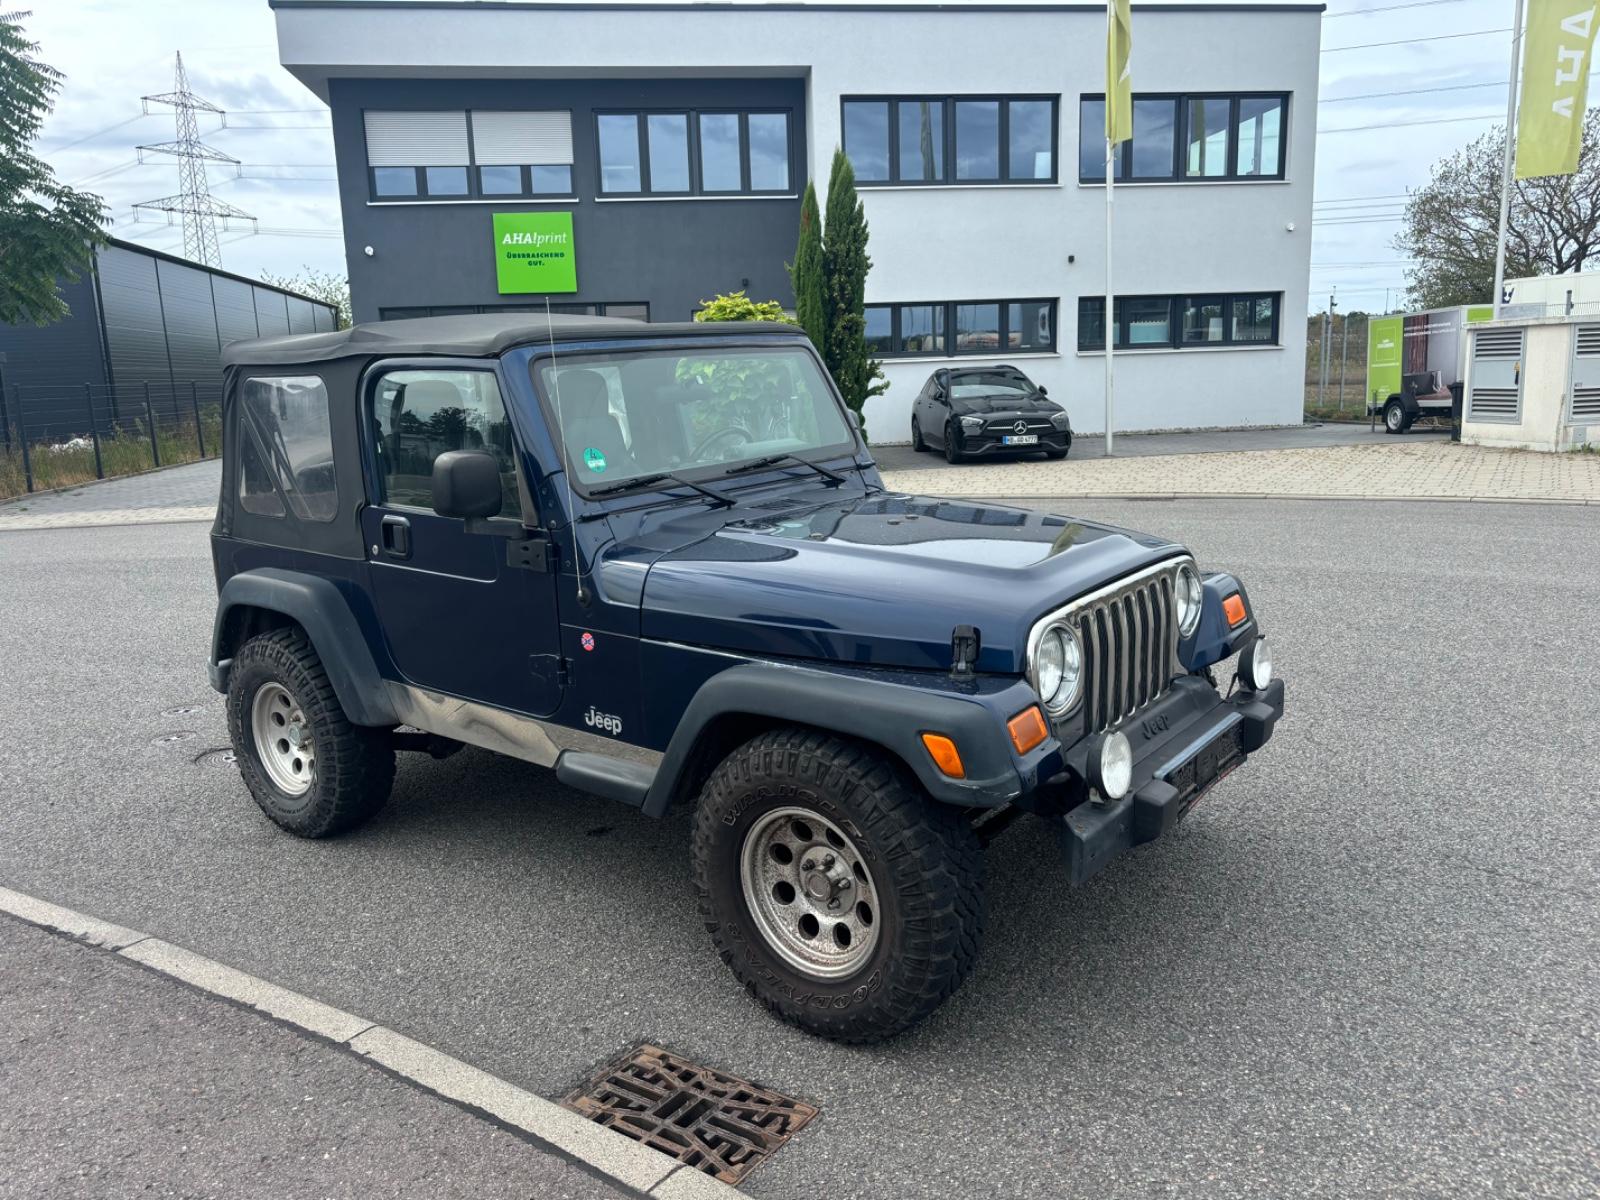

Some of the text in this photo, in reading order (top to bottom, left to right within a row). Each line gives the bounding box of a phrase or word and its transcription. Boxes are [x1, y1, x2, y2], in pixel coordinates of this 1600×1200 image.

[502, 232, 567, 247] AHA!print
[506, 251, 565, 259] ÜBERRASCHEND
[584, 705, 622, 735] Jeep
[1142, 714, 1169, 740] Jeep
